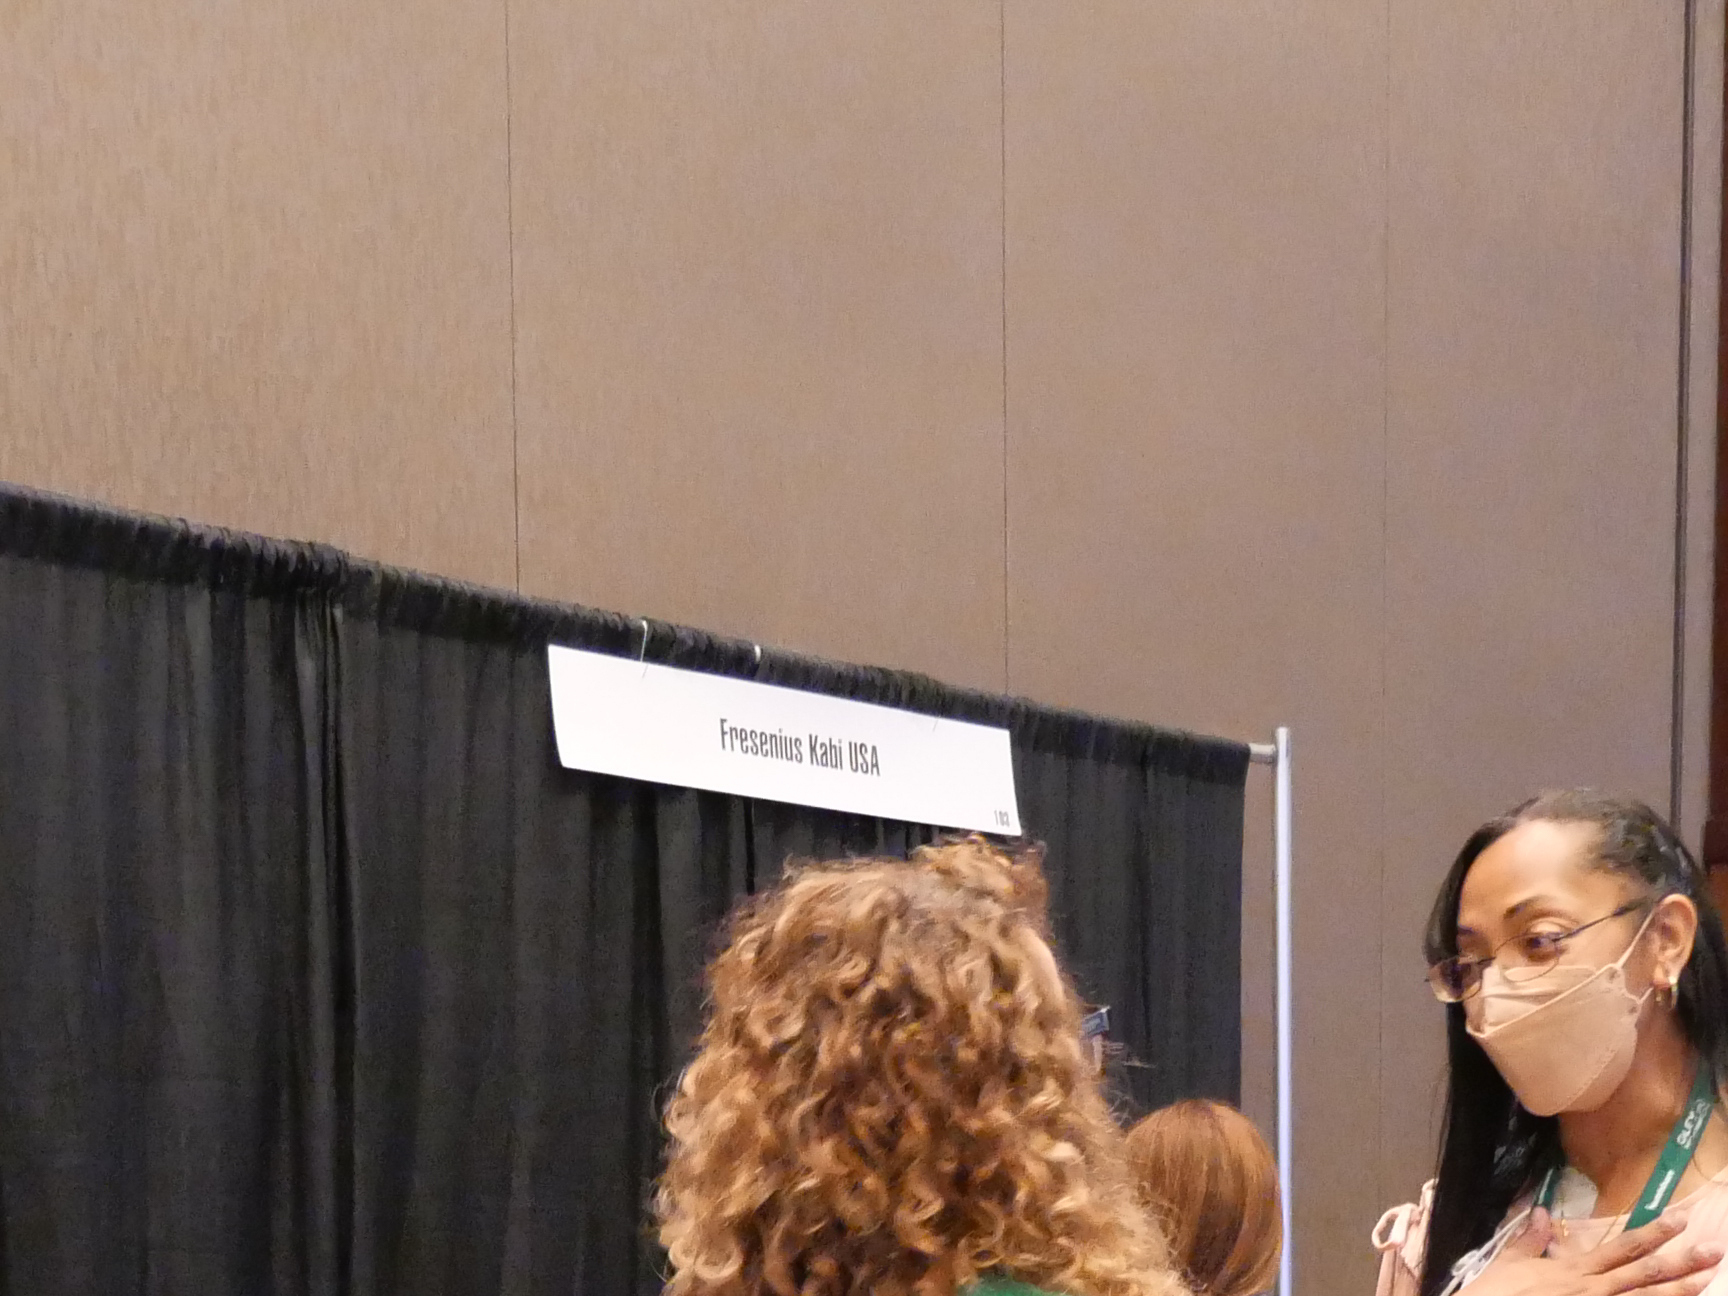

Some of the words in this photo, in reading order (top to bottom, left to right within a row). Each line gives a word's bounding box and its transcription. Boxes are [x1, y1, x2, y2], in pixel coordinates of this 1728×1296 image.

[719, 718, 804, 765] Fresenius
[810, 733, 843, 771] Kabi
[848, 743, 881, 778] USA
